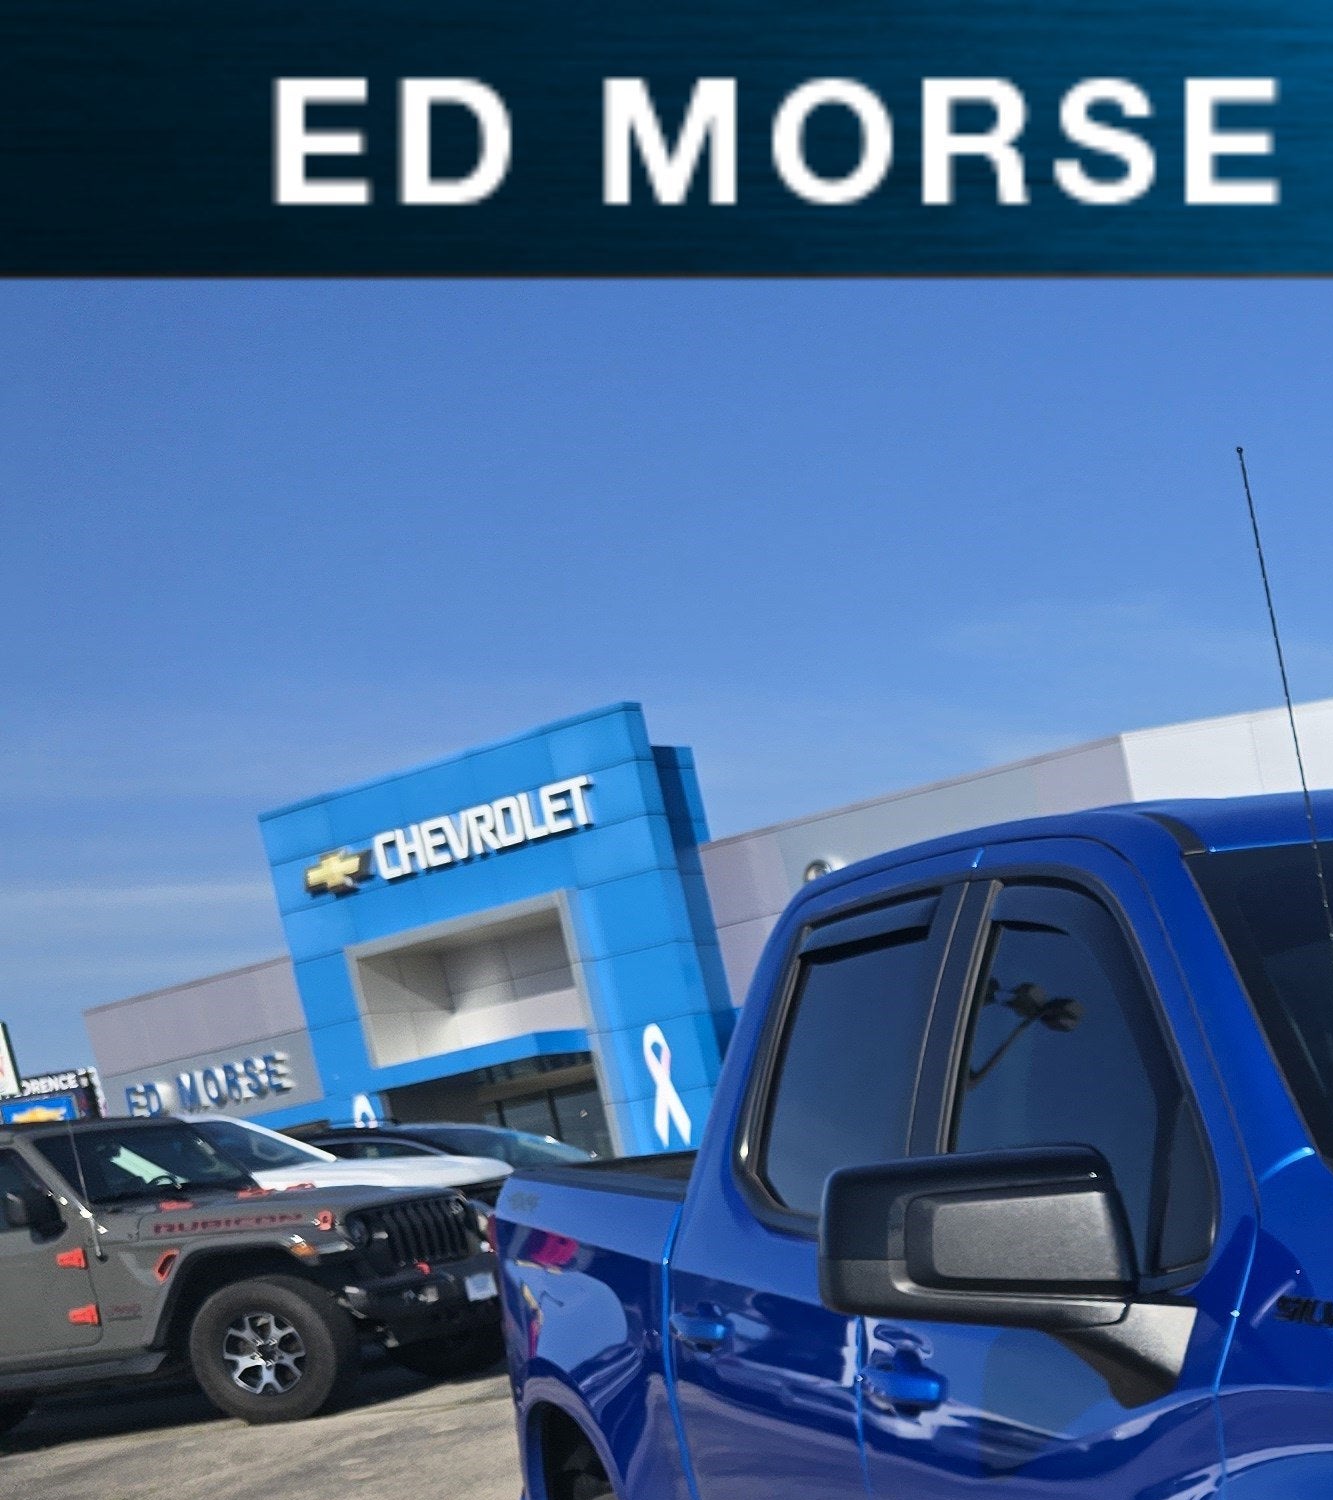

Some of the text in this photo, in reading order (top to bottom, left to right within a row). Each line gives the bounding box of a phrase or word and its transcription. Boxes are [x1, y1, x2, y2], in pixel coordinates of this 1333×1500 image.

[373, 774, 591, 880] CHEVROLET
[125, 1053, 290, 1117] ED MORSE
